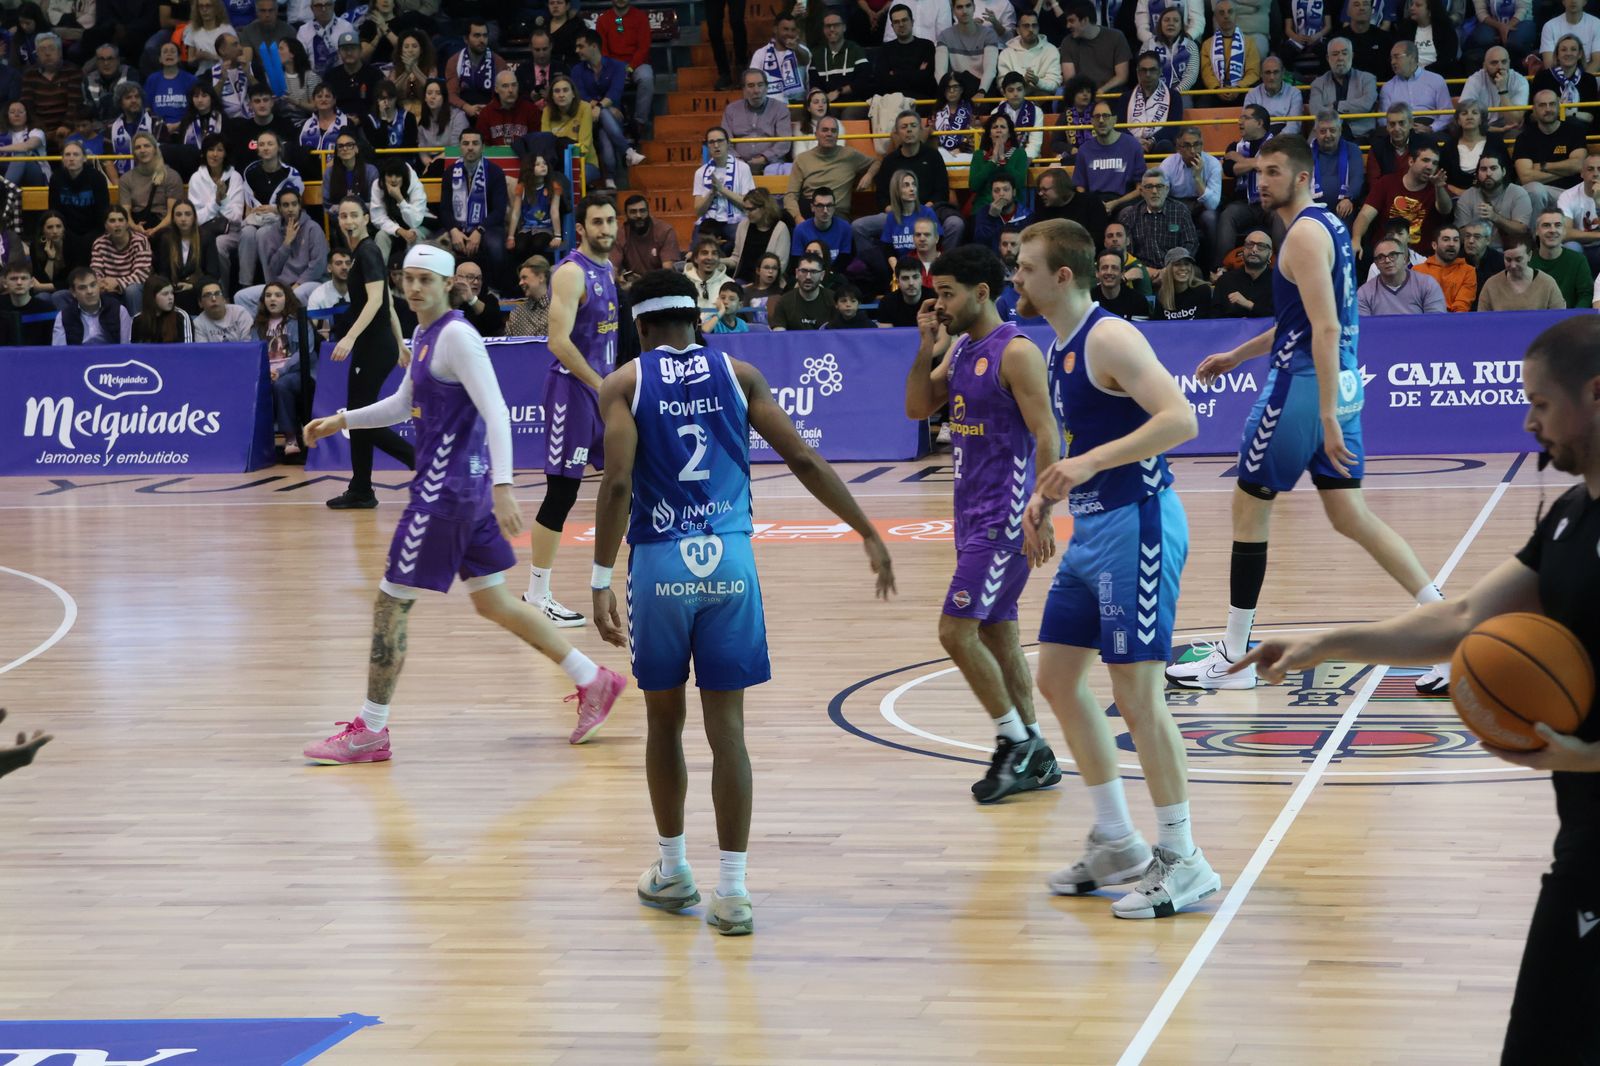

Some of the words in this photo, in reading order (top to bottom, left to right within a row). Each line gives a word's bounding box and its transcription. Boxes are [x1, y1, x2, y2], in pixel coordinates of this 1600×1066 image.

[1092, 157, 1123, 171] PUMA
[659, 354, 711, 385] gaza
[1387, 361, 1466, 387] CAJA
[99, 372, 149, 388] Melquiades
[658, 396, 724, 417] POWELL
[1389, 391, 1421, 408] DE
[1430, 388, 1532, 407] ZAMORA
[23, 396, 222, 453] Melquiades
[36, 450, 101, 465] Jamones
[102, 453, 114, 467] y
[116, 450, 190, 465] embutidos
[676, 423, 711, 482] 2
[682, 499, 733, 520] INNOVA
[680, 520, 709, 531] Chef
[655, 578, 746, 597] MORALEJO
